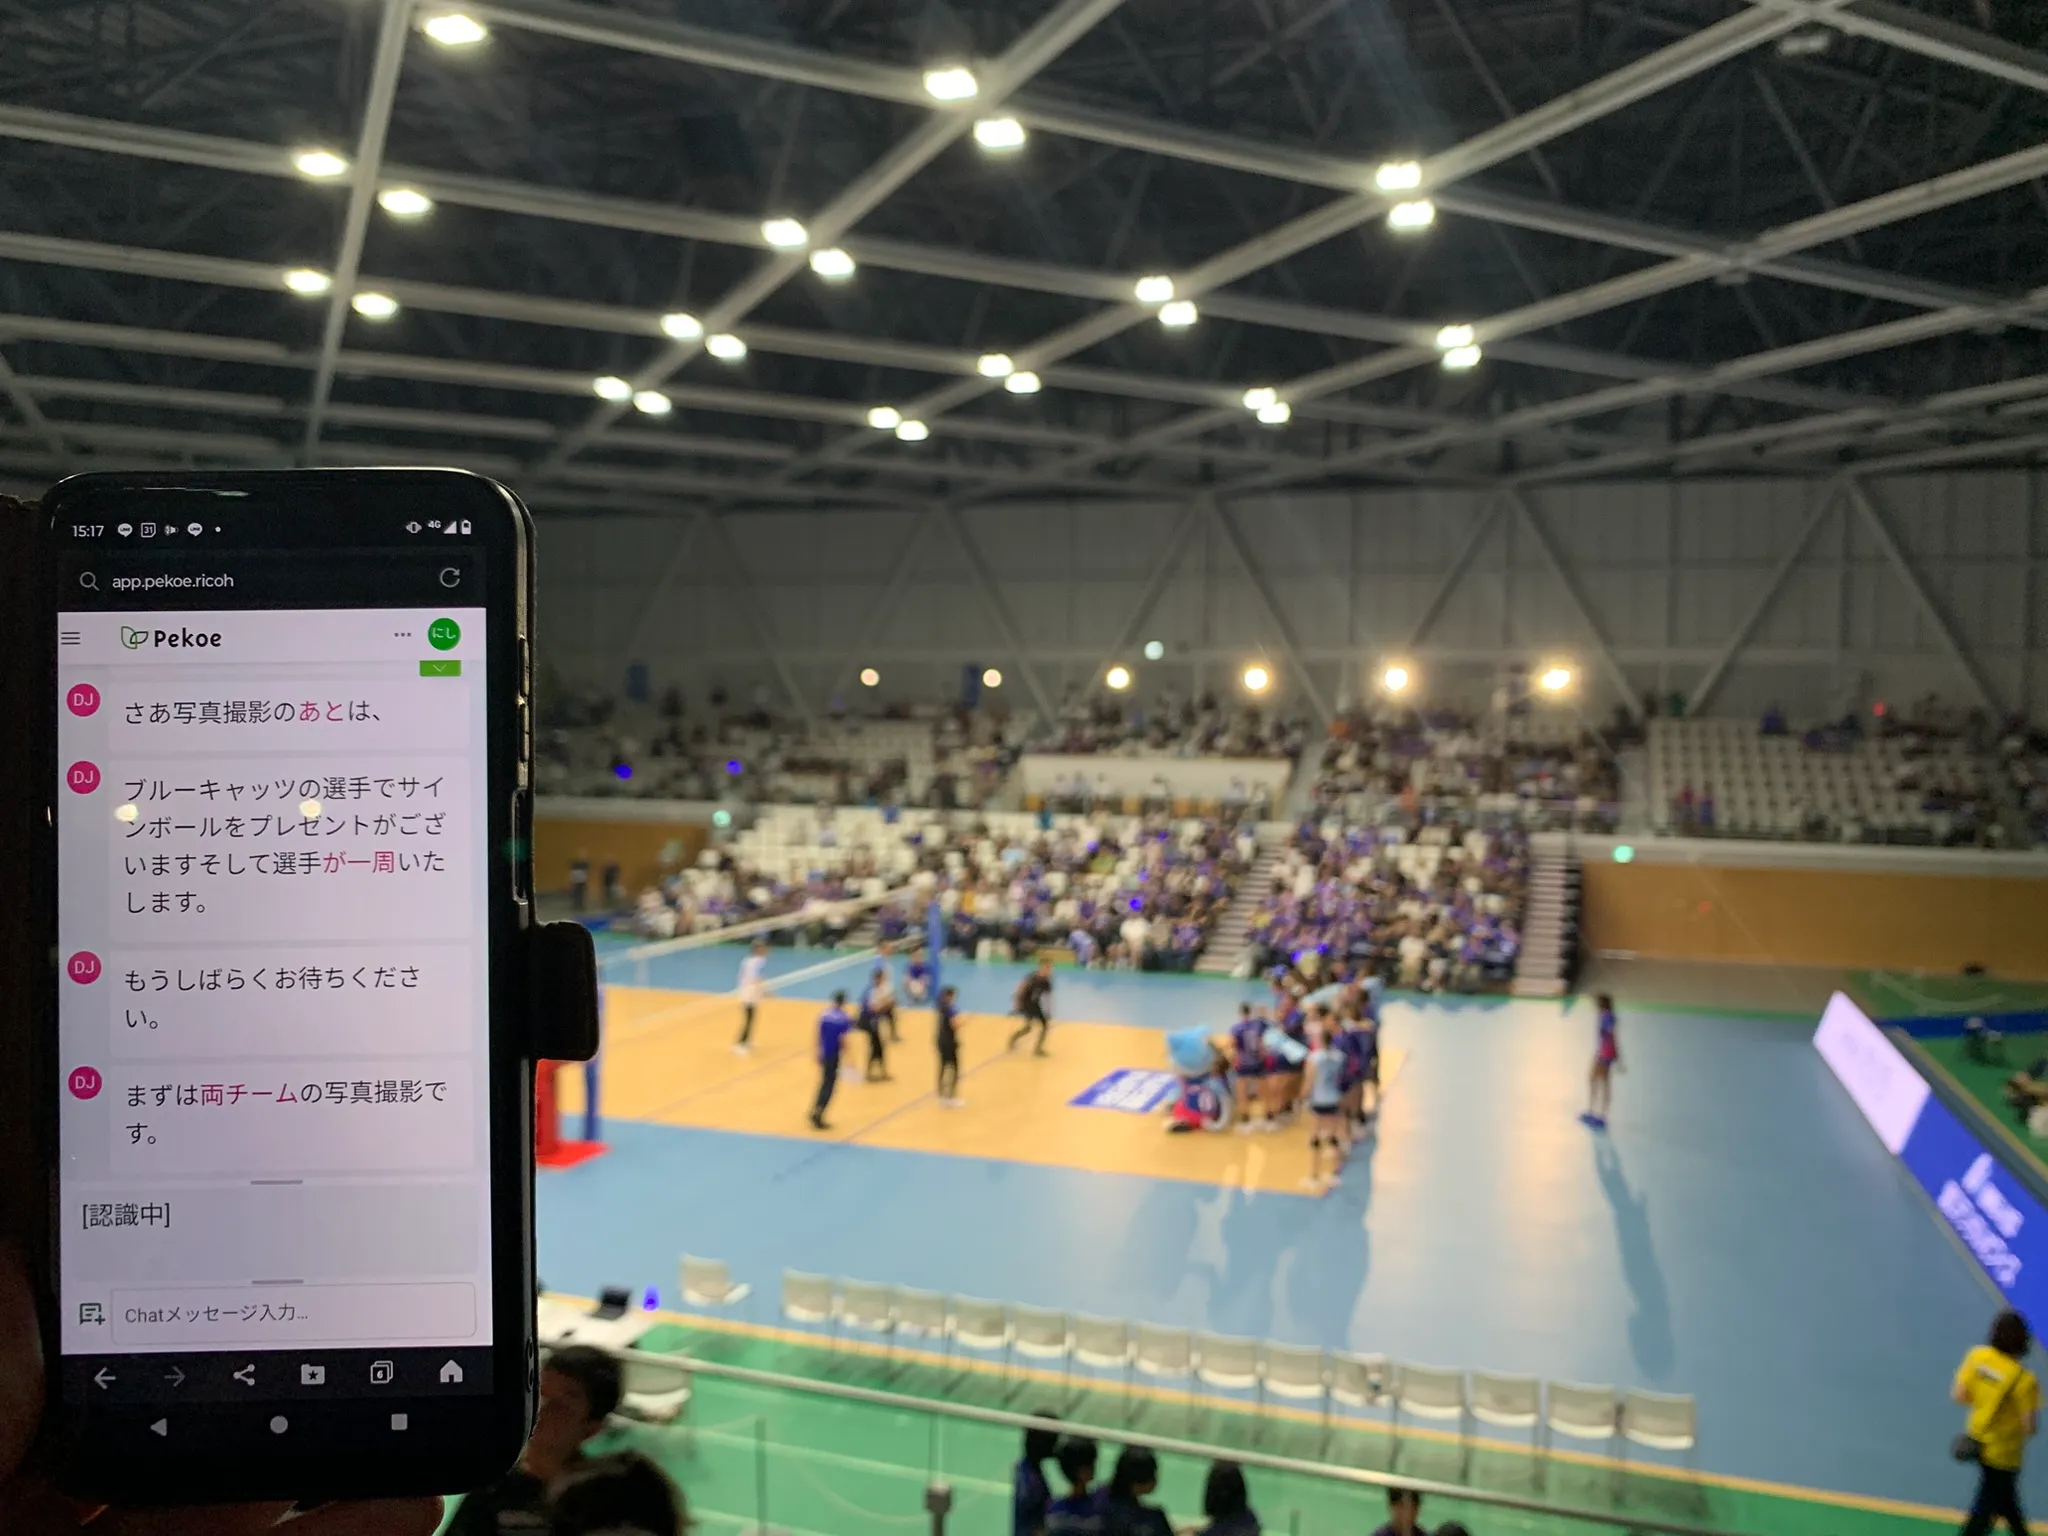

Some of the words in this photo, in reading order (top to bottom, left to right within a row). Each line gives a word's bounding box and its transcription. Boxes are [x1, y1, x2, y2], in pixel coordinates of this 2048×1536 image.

[72, 525, 104, 538] 15:17
[143, 525, 154, 535] 31
[427, 519, 442, 529] 4G
[112, 573, 234, 592] app.pekoe.ricoh
[153, 627, 222, 648] Pekoe
[432, 626, 457, 640] にし
[73, 692, 94, 707] DJ
[125, 700, 381, 725] さあ写真撮影のあとは、
[73, 770, 94, 785] DJ
[125, 776, 444, 801] ブルーキャッツの選手でサイ
[125, 812, 447, 839] ンボールをプレゼントがござ
[124, 850, 446, 876] いますそして選手が一周いた
[127, 891, 206, 914] します。
[74, 960, 95, 975] DJ
[125, 966, 420, 992] もうしばらくお待ちくださ
[125, 1009, 159, 1030] い。
[75, 1075, 96, 1090] DJ
[127, 1080, 447, 1107] まずは両チームの写真撮影で
[125, 1122, 157, 1145] す。
[82, 1202, 171, 1230] [認識中]
